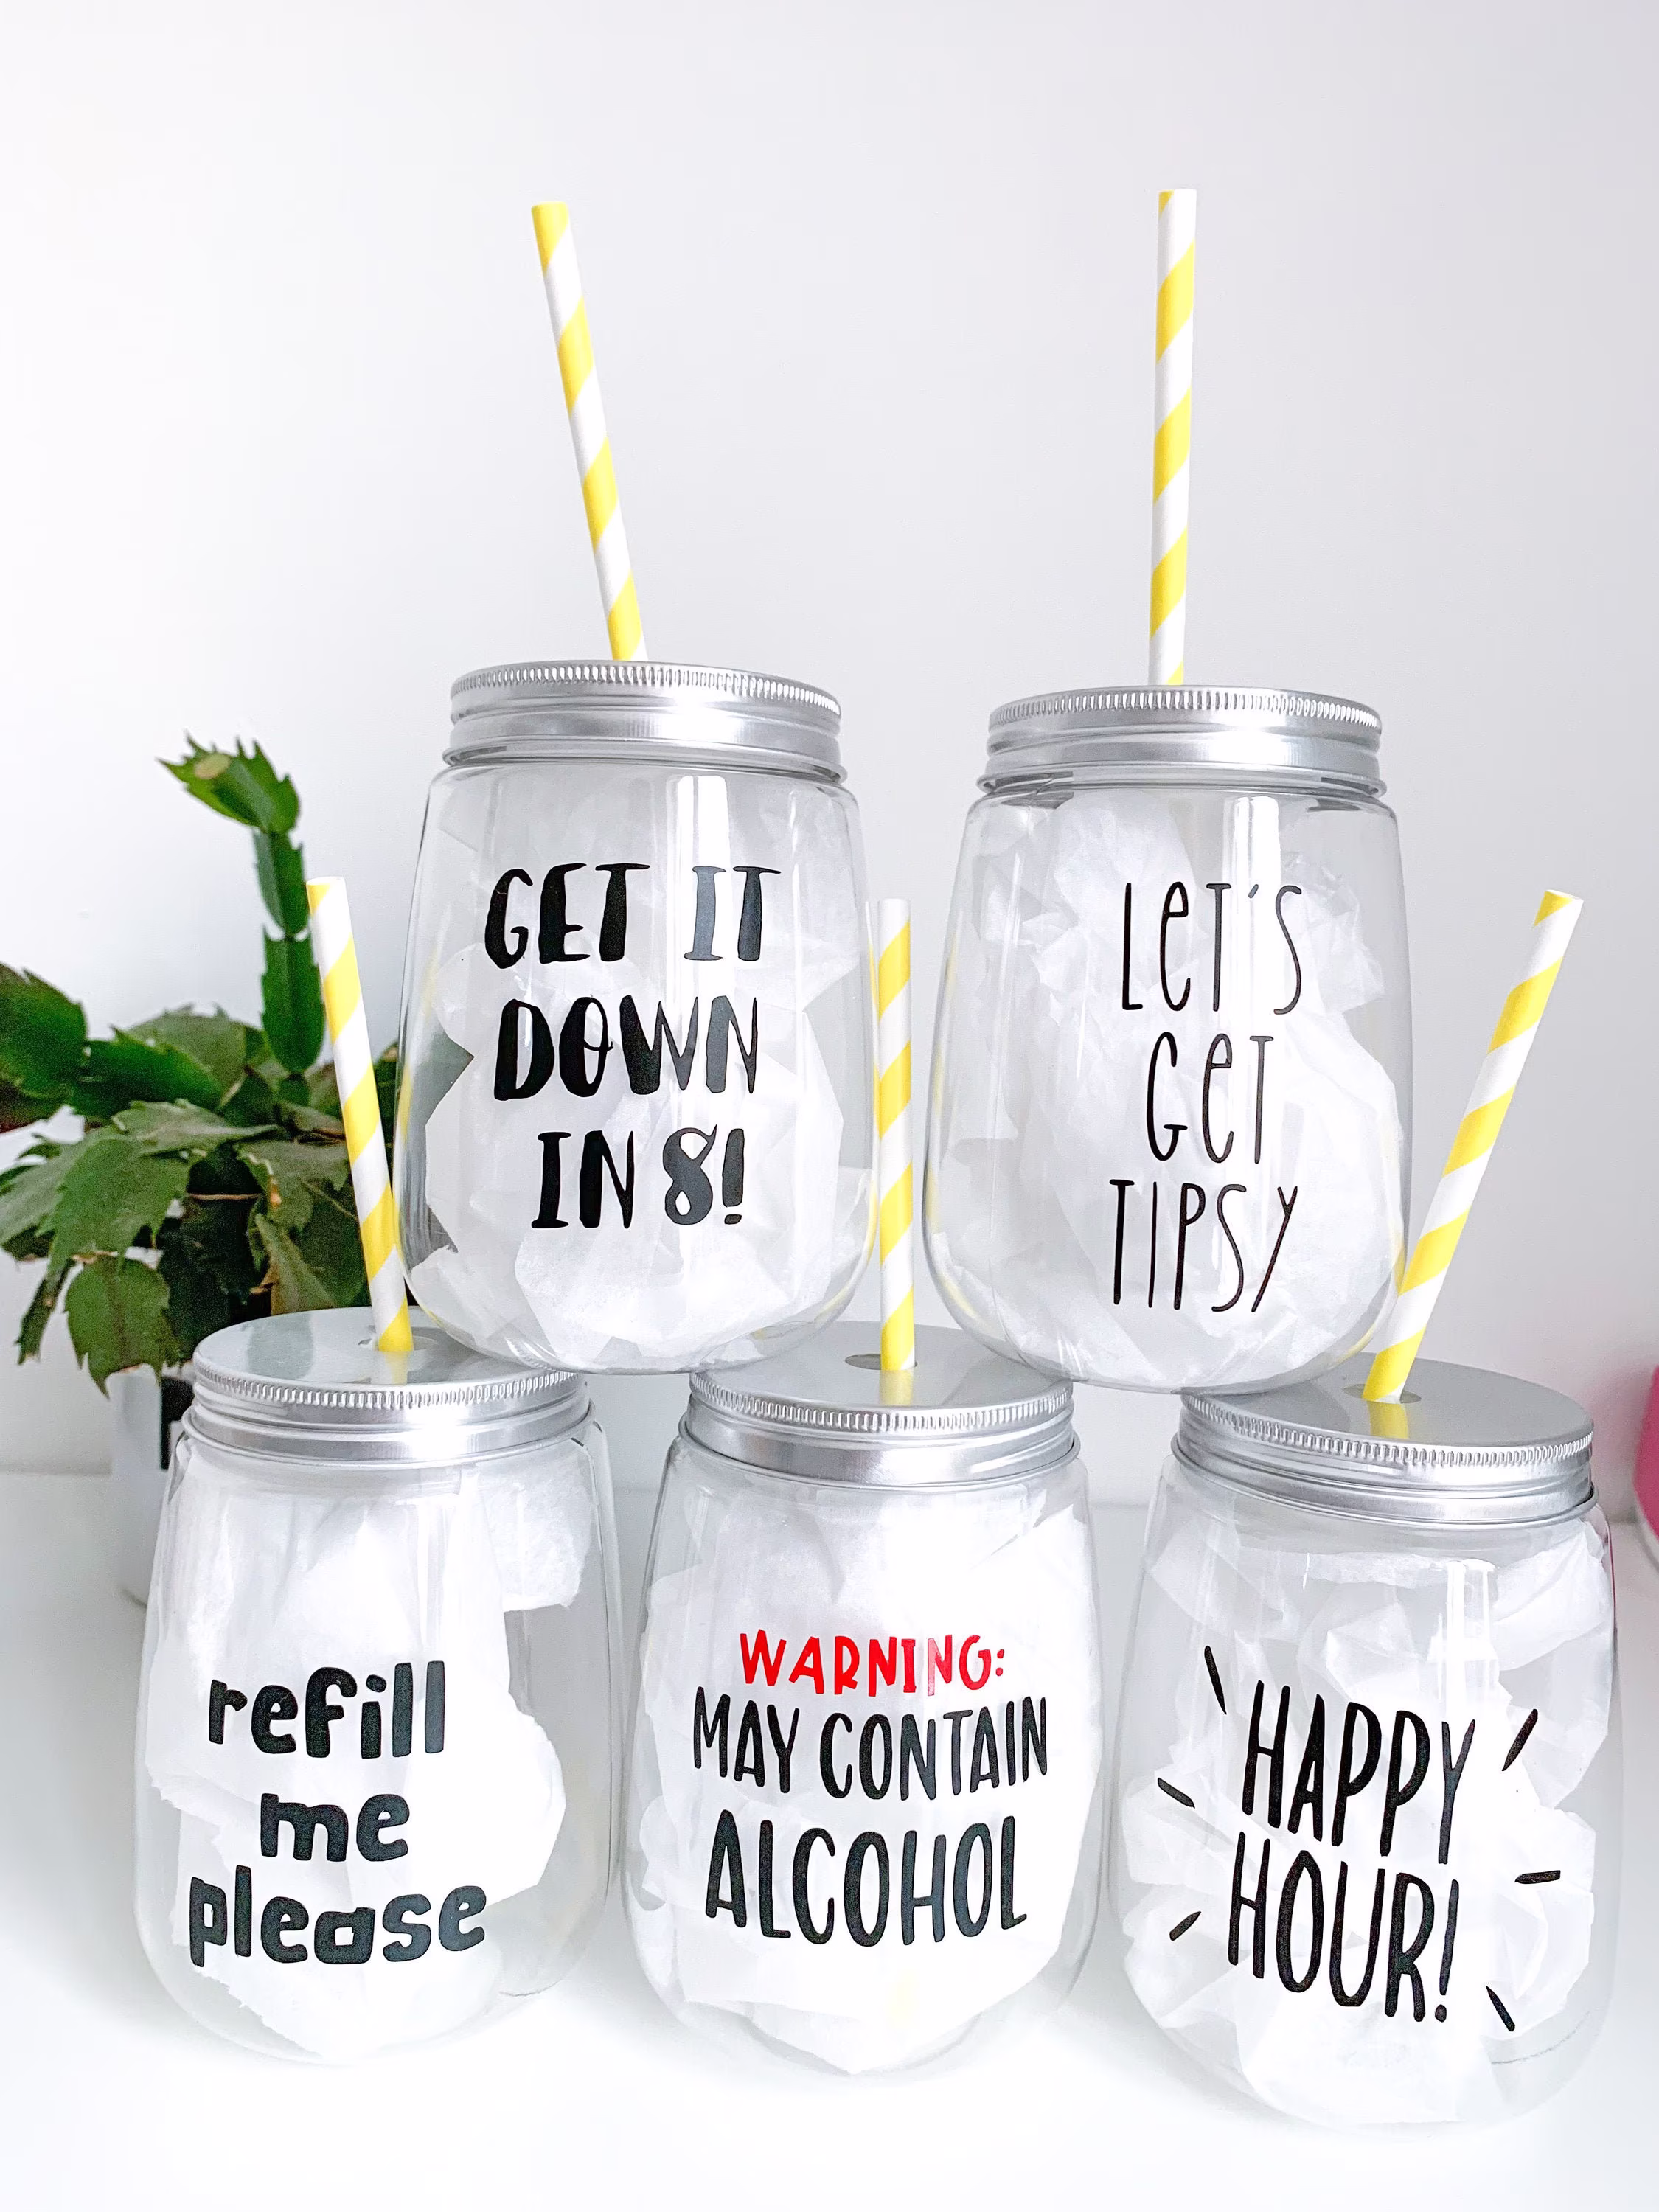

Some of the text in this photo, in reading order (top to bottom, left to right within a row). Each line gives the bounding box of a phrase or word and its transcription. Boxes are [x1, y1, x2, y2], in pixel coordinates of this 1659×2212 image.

[484, 863, 782, 970] GET IT
[493, 994, 759, 1102] DOWN
[531, 1124, 745, 1229] IN 8!
[1109, 1178, 1298, 1313] TIPSY
[209, 1660, 446, 1759] refill
[740, 1629, 1005, 1698] WARNING:
[693, 1686, 801, 1794] MAY
[819, 1696, 1048, 1801] CONTAIN
[260, 1792, 410, 1863] me
[705, 1680, 1475, 1947] ALCOHOL HAPPY
[189, 1865, 487, 1968] please
[1228, 1831, 1460, 2024] HOUR!
